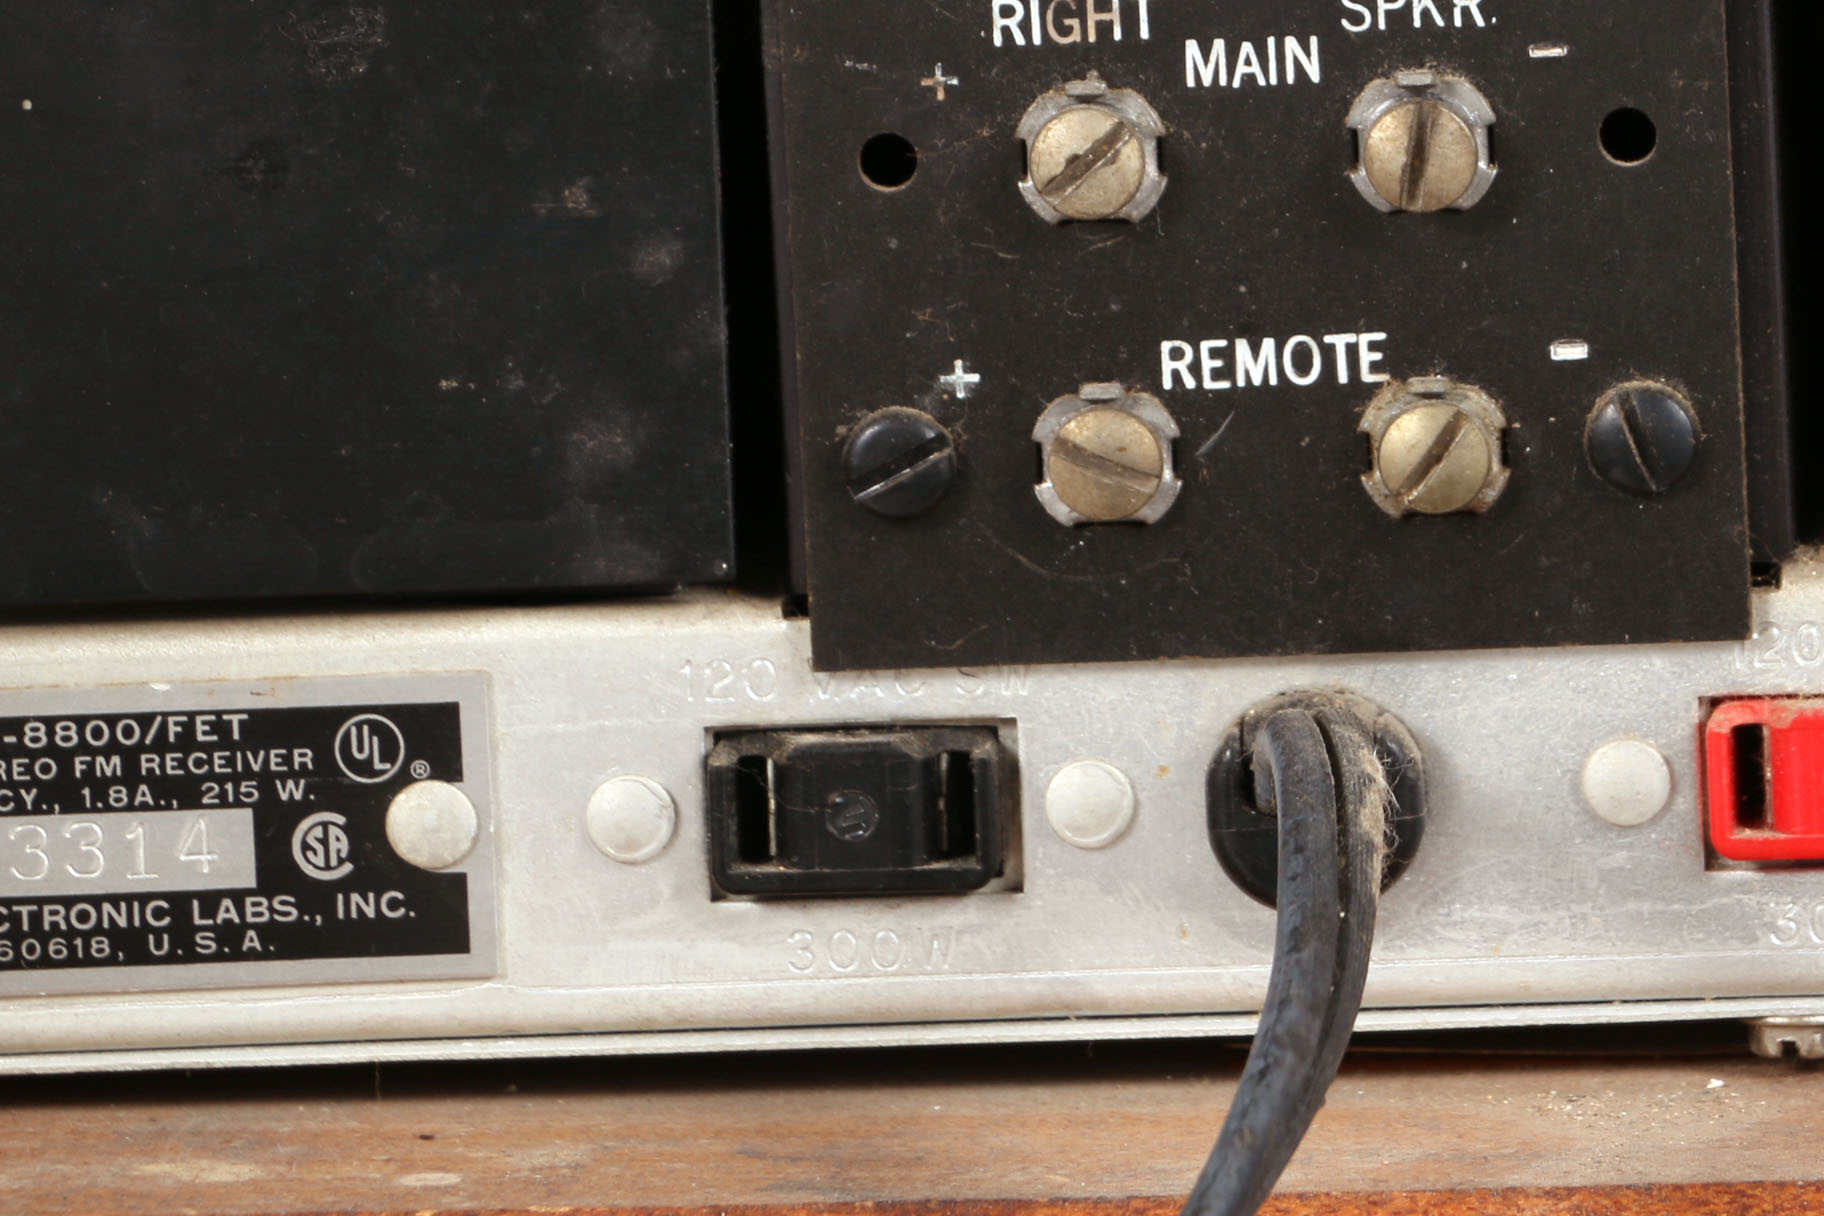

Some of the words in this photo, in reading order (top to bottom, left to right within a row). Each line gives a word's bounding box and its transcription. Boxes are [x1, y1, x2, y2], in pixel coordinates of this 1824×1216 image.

[1184, 34, 1321, 89] MAIN
[1160, 332, 1388, 390] REMOTE
[680, 657, 777, 702] 120
[74, 754, 122, 779] FM
[140, 747, 314, 776] RECEIVER
[201, 780, 259, 805] 215
[276, 778, 316, 803] W.
[10, 816, 219, 881] 3314
[192, 896, 324, 927] LABS.,
[335, 890, 417, 921] INC.
